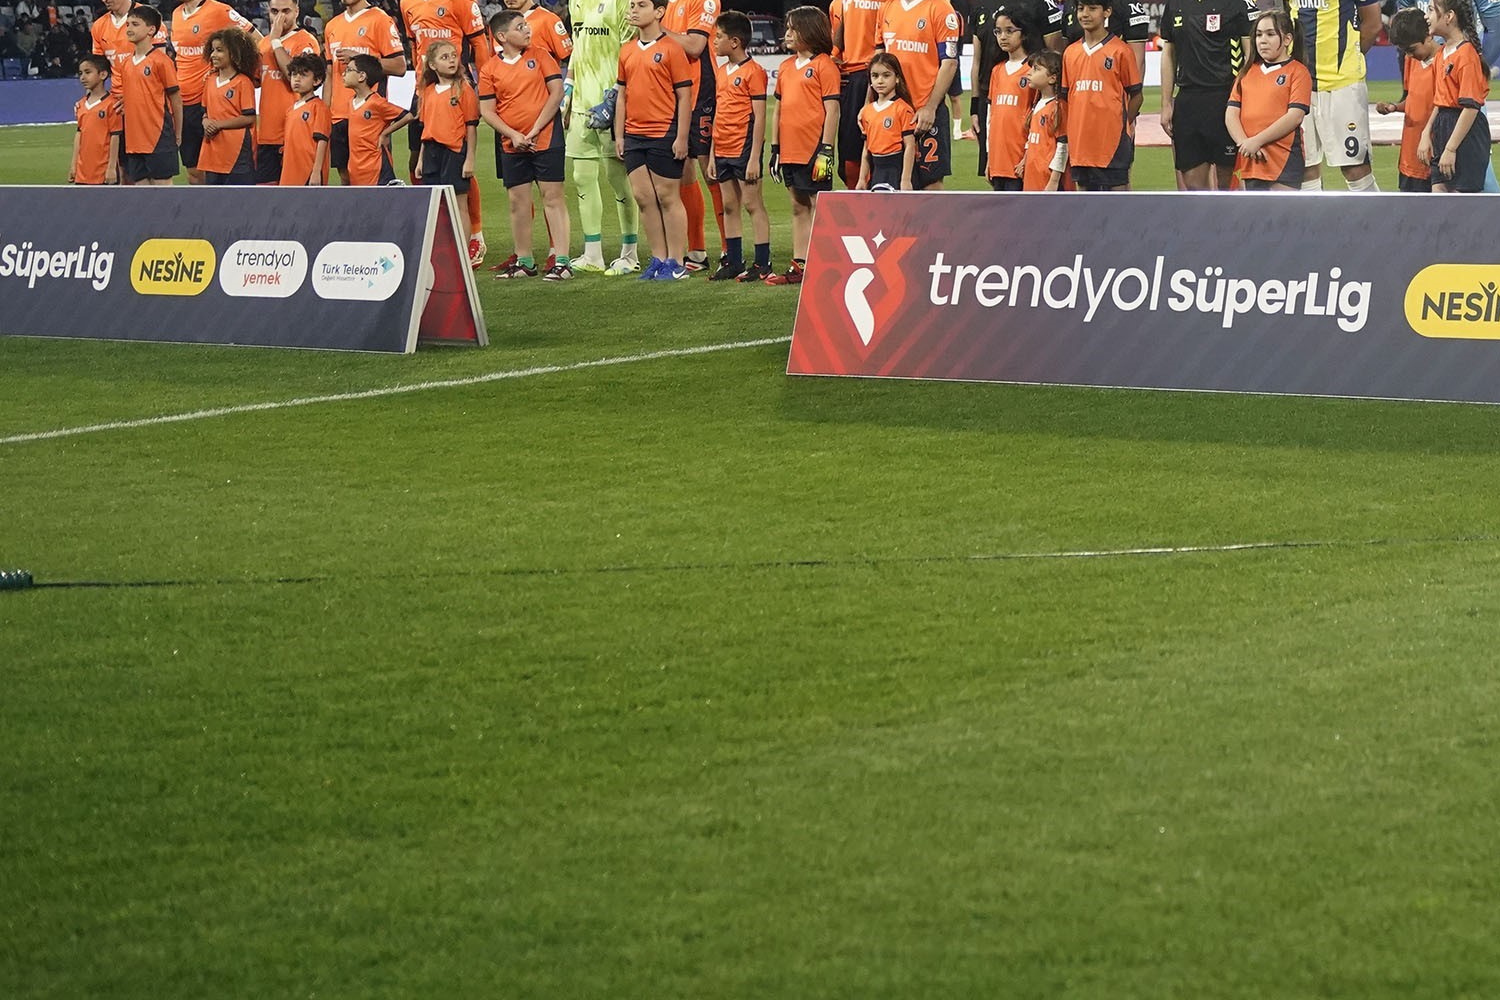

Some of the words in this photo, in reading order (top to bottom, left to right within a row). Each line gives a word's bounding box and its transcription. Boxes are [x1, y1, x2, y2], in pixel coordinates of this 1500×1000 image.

[585, 27, 609, 36] TODINI
[895, 39, 929, 53] TODINI
[1075, 80, 1103, 92] SAYGI
[923, 137, 939, 163] 2
[1344, 135, 1360, 158] 9
[236, 249, 296, 268] trendyol
[322, 263, 340, 274] Türk
[343, 264, 378, 276] Telekom
[243, 272, 281, 287] yemek
[928, 252, 1165, 323] trendyol
